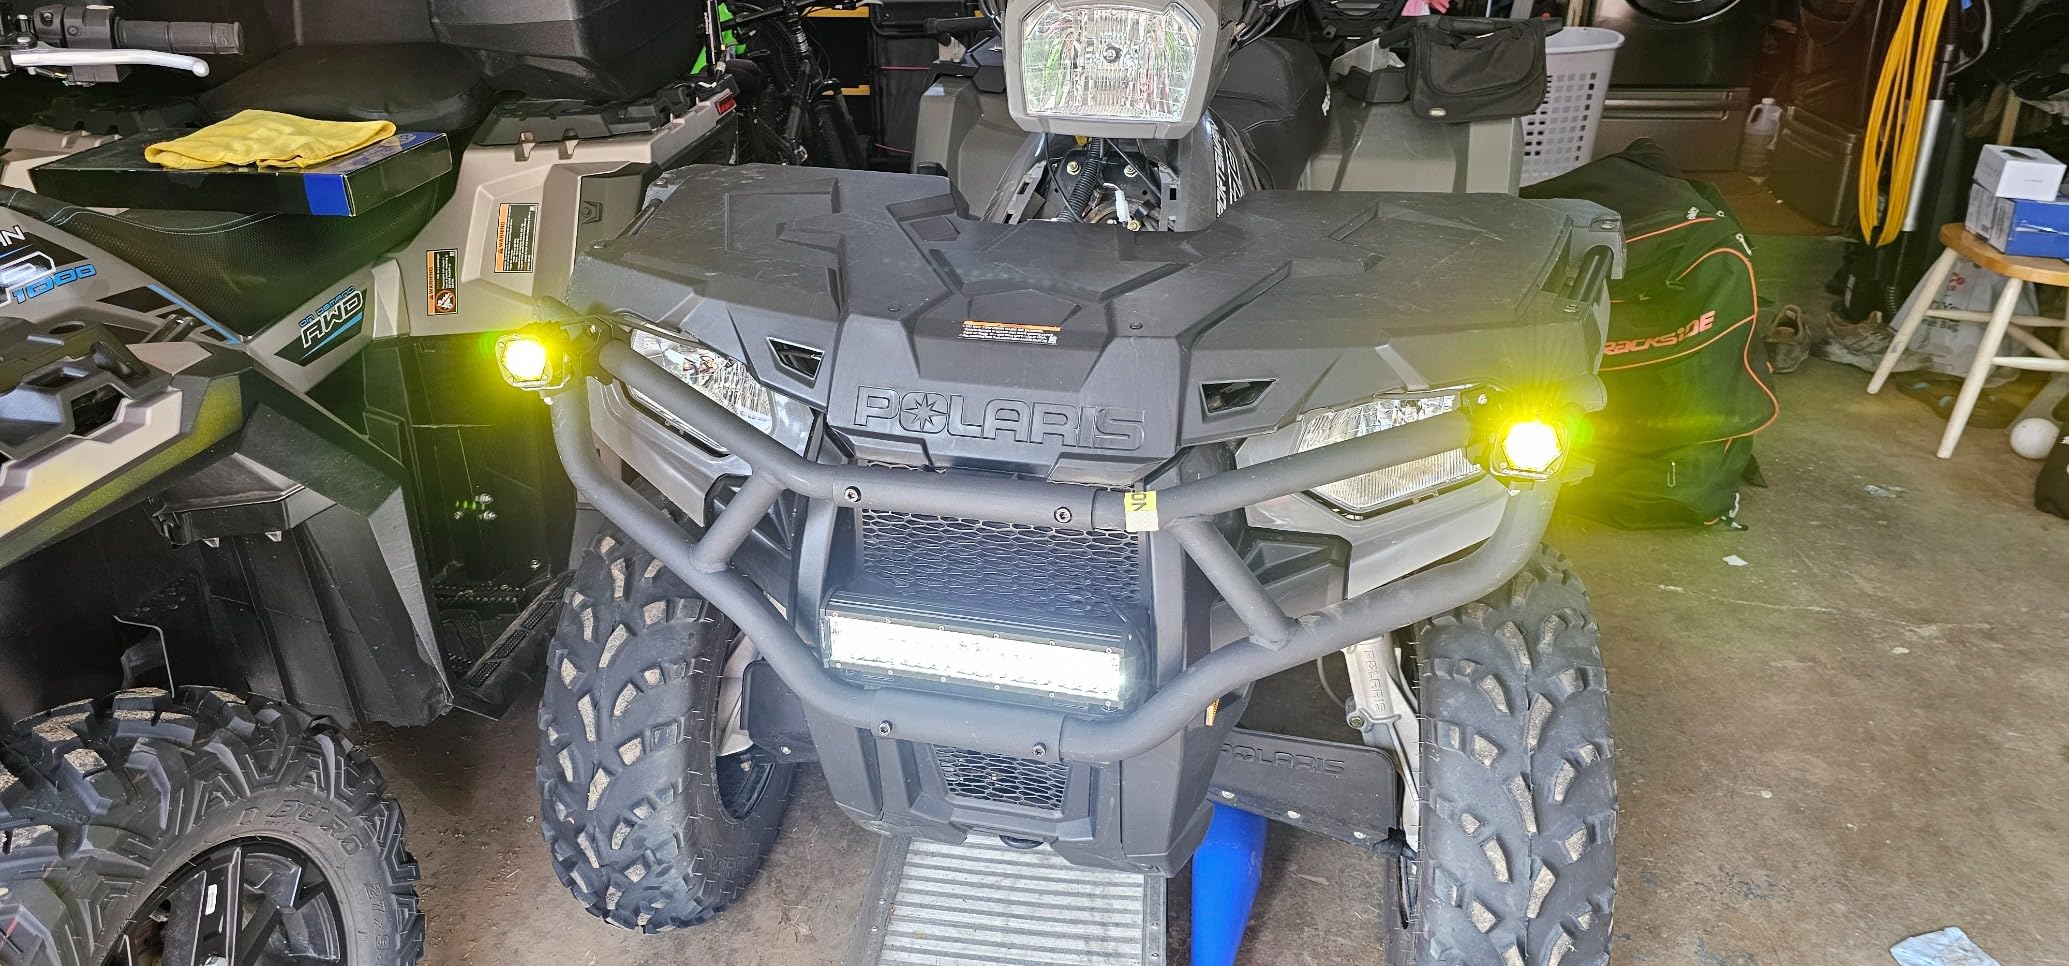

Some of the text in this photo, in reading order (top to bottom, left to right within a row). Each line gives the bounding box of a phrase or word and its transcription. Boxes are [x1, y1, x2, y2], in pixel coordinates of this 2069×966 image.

[1209, 119, 1227, 217] PORTSMAN
[12, 263, 97, 304] 1000
[300, 290, 363, 349] AWD
[853, 385, 1146, 451] POLARIS
[1363, 648, 1386, 714] POLARIS
